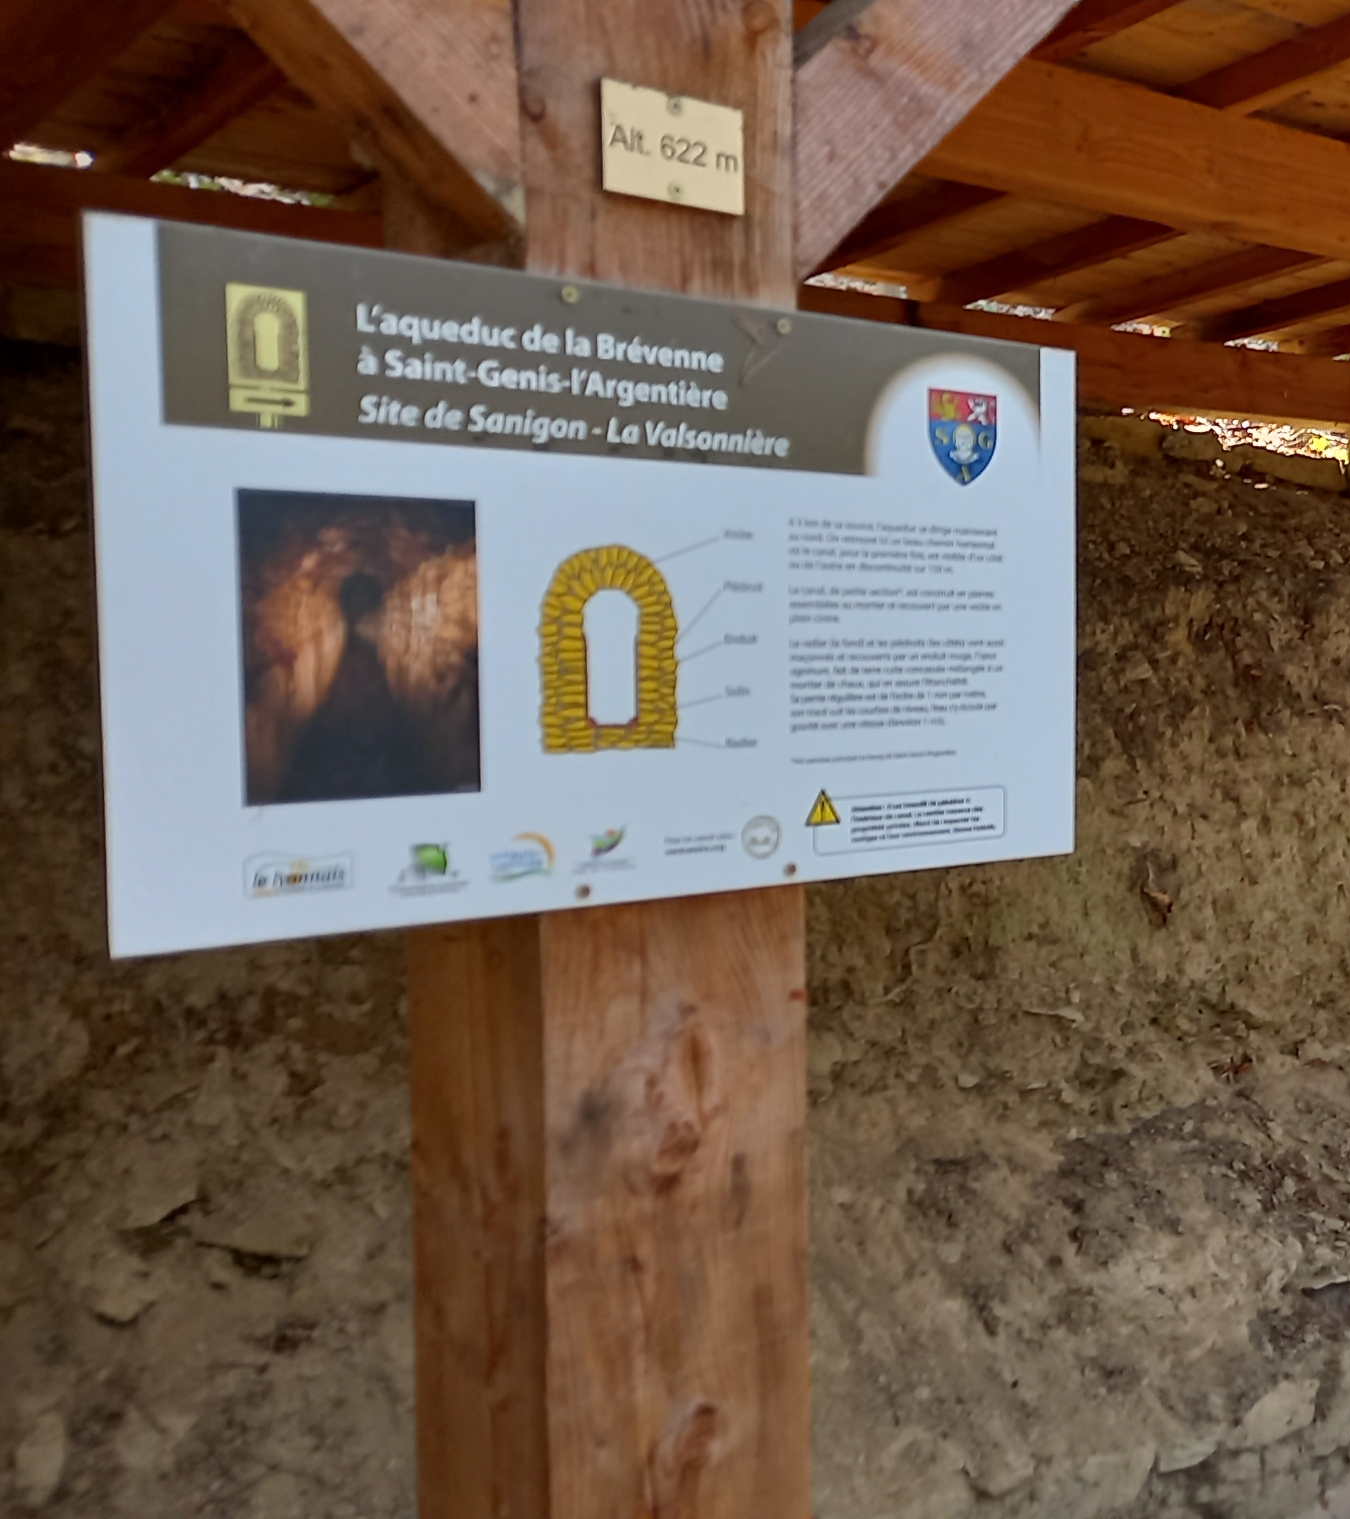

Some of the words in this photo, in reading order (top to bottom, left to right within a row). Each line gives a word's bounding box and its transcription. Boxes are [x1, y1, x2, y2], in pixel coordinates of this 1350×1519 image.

[609, 124, 651, 156] Alt.
[660, 134, 708, 168] 622
[715, 152, 739, 173] m
[356, 303, 517, 349] L'aqueduc
[522, 323, 561, 355] de
[565, 327, 591, 357] la
[598, 333, 724, 374] Brévenne
[357, 346, 379, 376] à
[384, 349, 729, 411] Saint-Genis-l'Argentière
[358, 395, 418, 428] Site
[424, 401, 463, 431] de
[467, 404, 588, 444] Sanigon
[607, 417, 640, 446] La
[645, 420, 790, 458] Valsonnière
